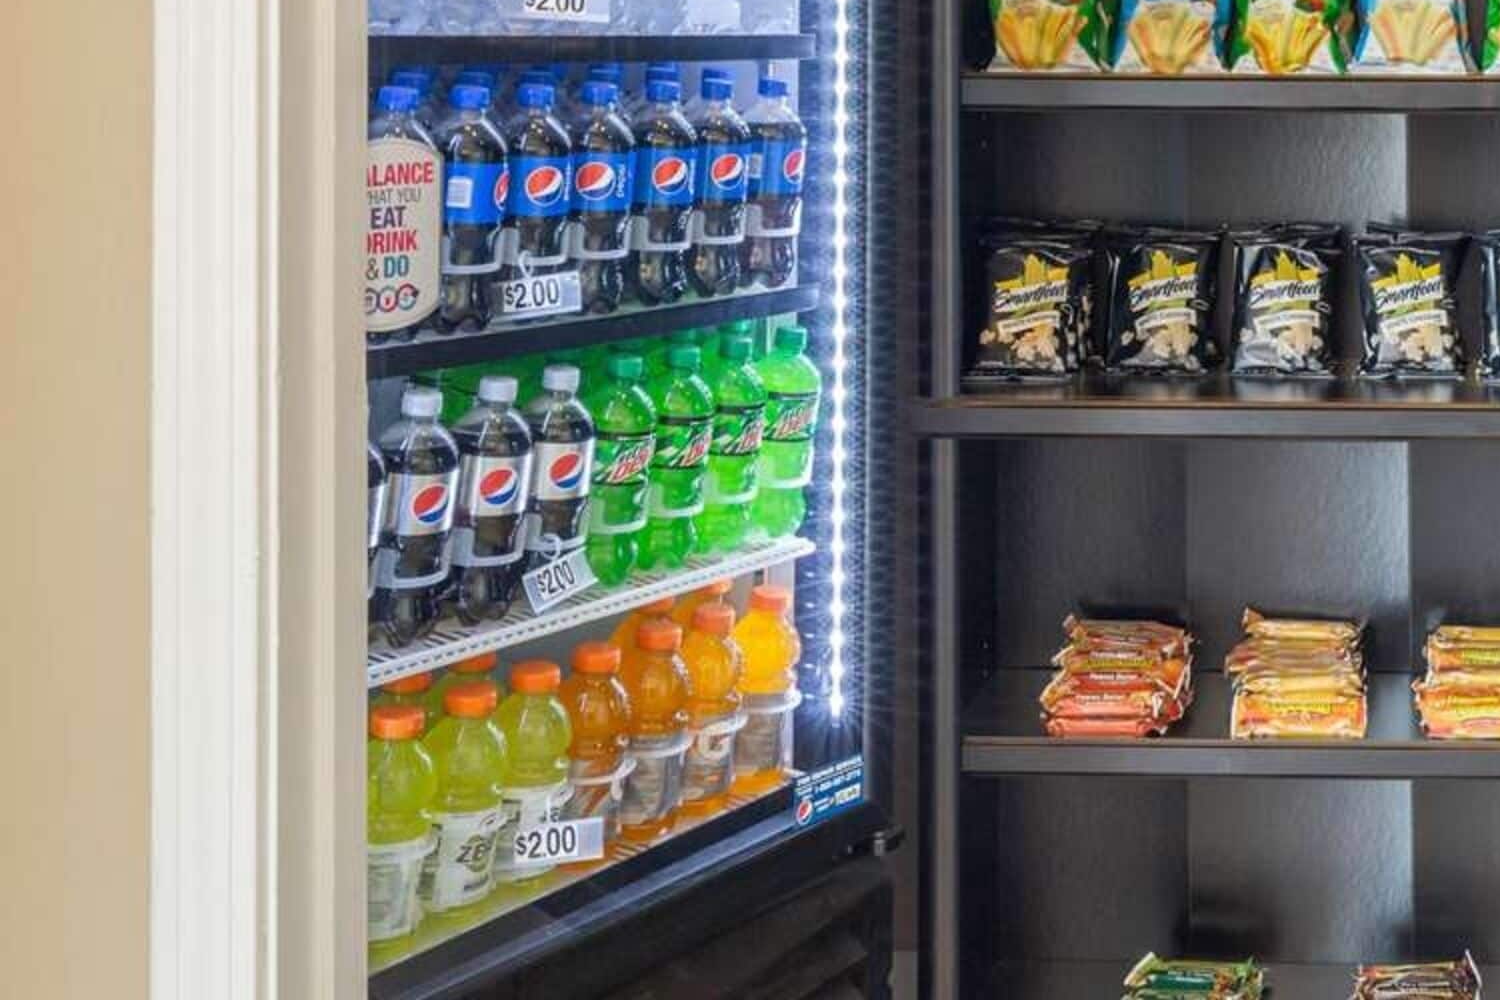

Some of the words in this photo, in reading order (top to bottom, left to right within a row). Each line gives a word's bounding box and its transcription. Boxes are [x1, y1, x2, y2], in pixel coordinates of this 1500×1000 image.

[367, 161, 433, 188] LANCE
[371, 205, 406, 229] EAT
[366, 258, 379, 280] &
[383, 254, 409, 279] DO
[505, 277, 560, 309] $2.00
[515, 825, 577, 859] $2.00
